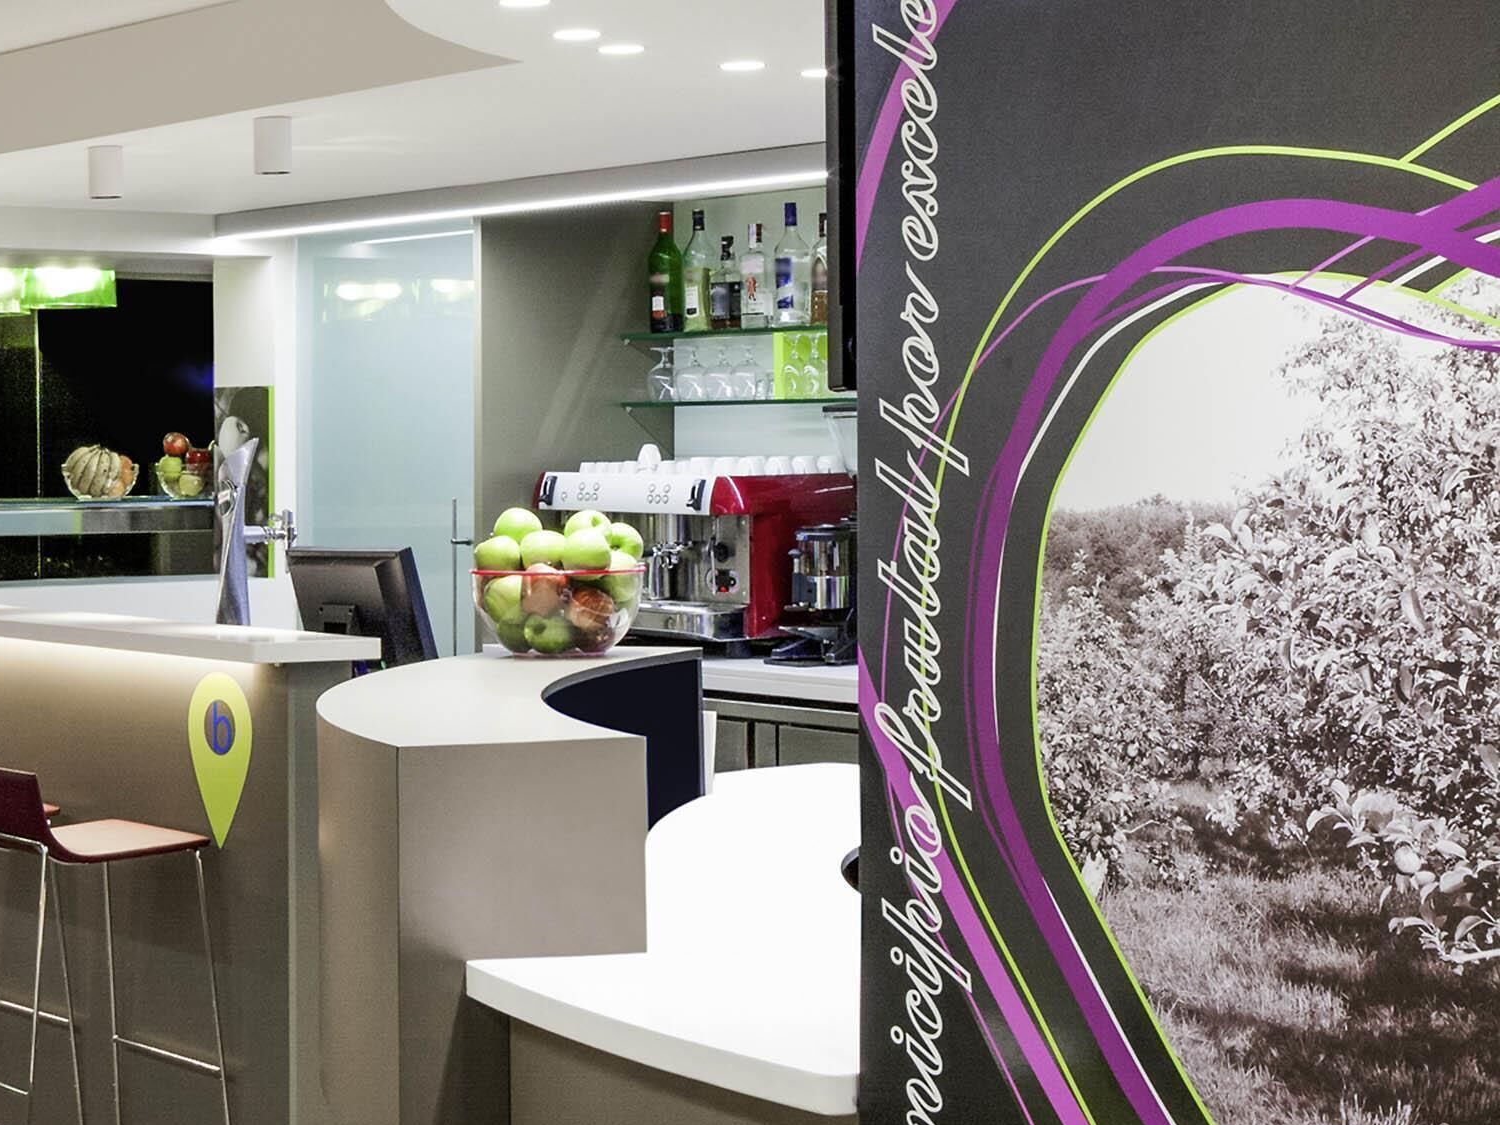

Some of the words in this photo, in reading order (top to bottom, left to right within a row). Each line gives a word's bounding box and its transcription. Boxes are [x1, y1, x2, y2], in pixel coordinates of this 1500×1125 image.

[871, 0, 938, 261] excele
[878, 261, 971, 477] por
[874, 450, 973, 812] frutal
